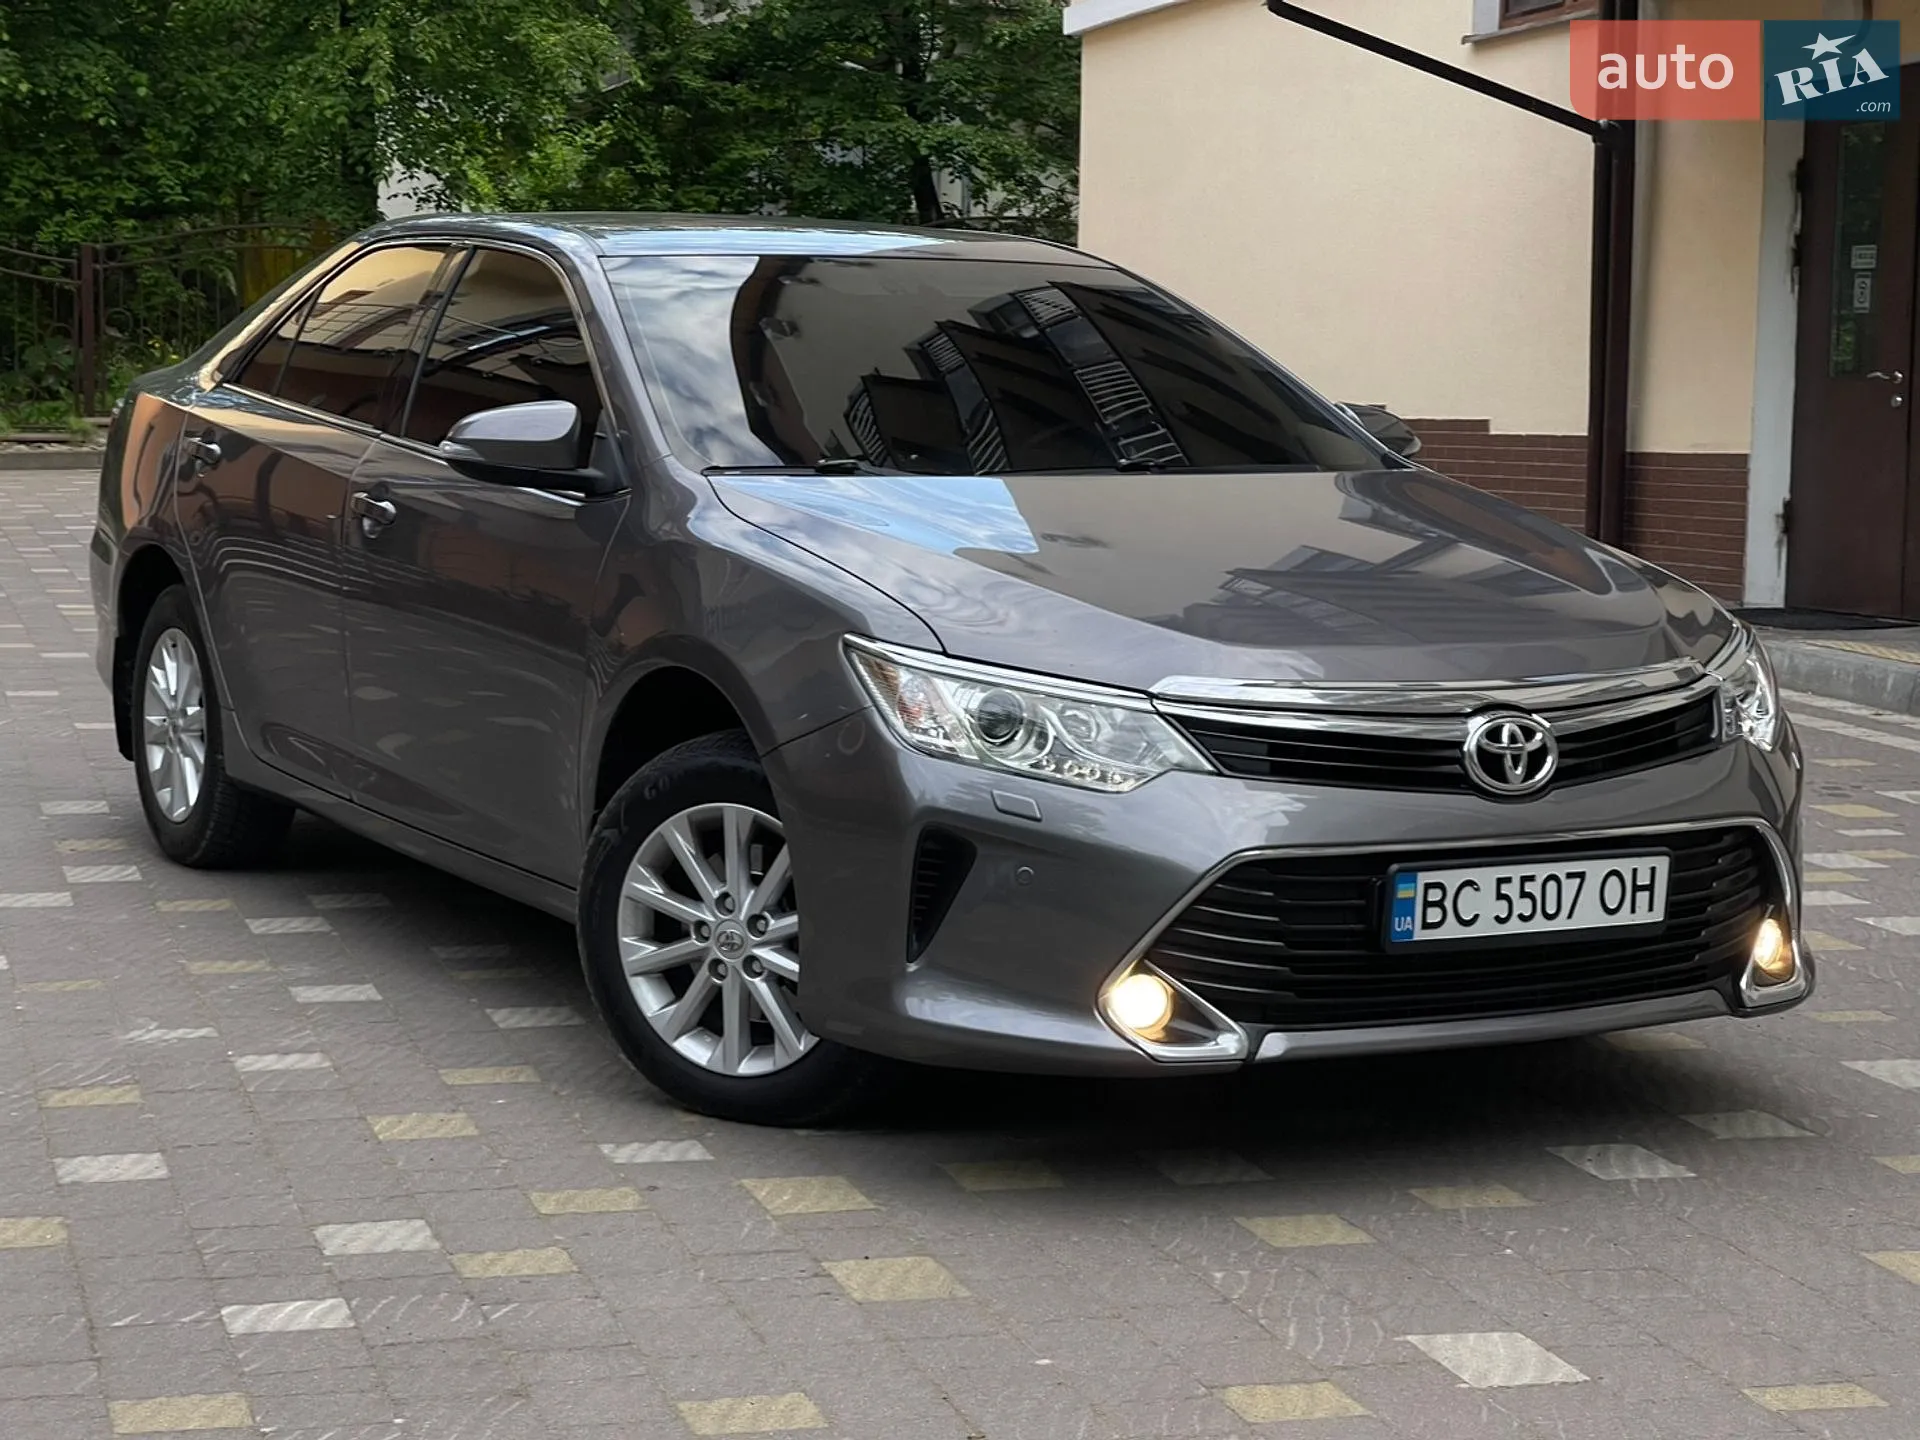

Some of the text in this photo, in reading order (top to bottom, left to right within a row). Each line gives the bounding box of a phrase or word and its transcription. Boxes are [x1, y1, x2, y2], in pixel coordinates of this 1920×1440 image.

[1420, 865, 1657, 931] BC 5507 OH
[1394, 916, 1413, 932] UA
